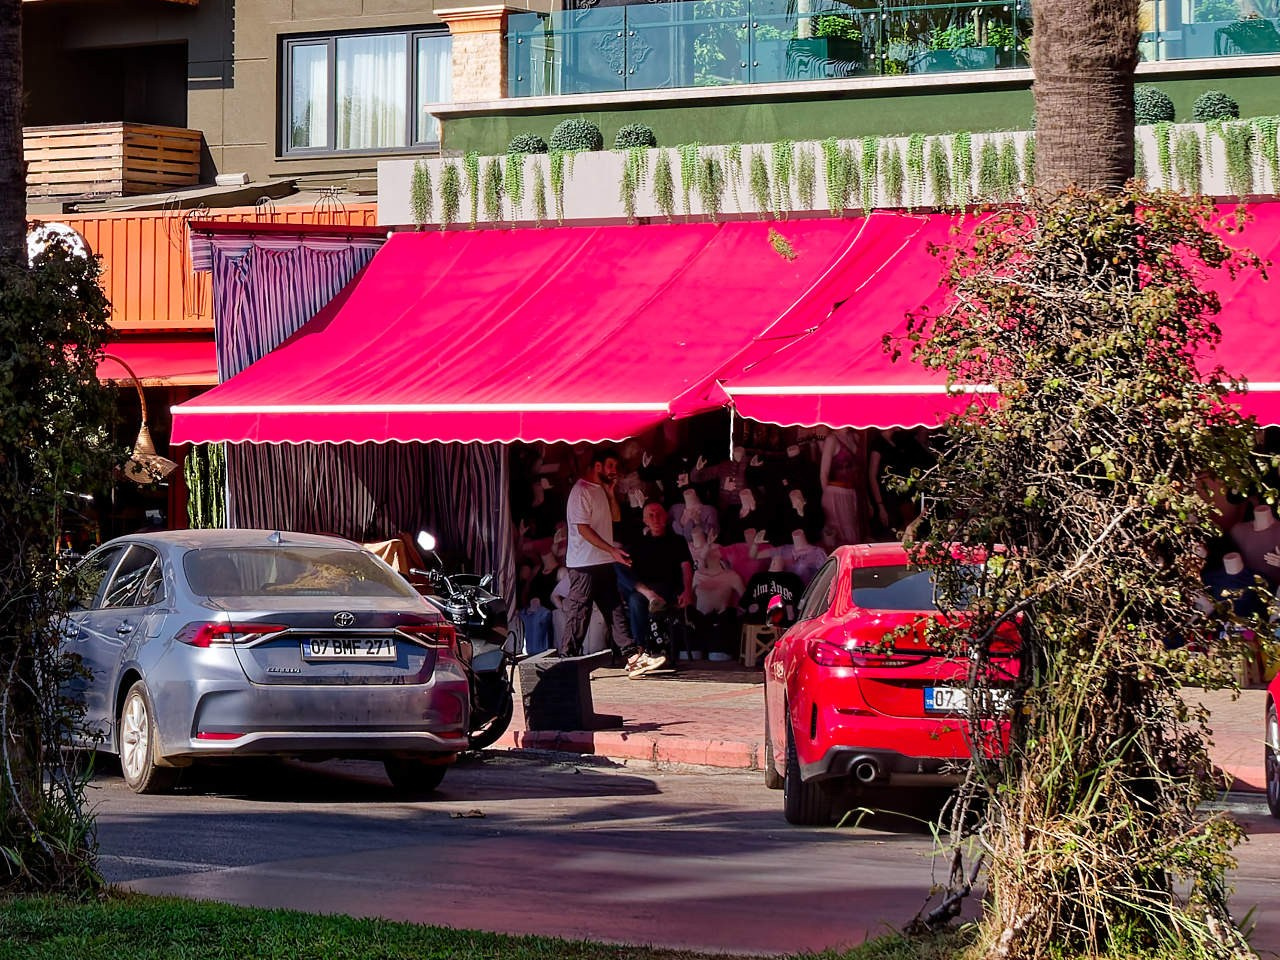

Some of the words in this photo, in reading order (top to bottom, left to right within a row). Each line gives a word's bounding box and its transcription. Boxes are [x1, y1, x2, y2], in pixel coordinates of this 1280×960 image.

[310, 640, 328, 655] 07
[333, 640, 361, 655] BMF
[366, 640, 392, 655] 271
[935, 690, 954, 707] 07
